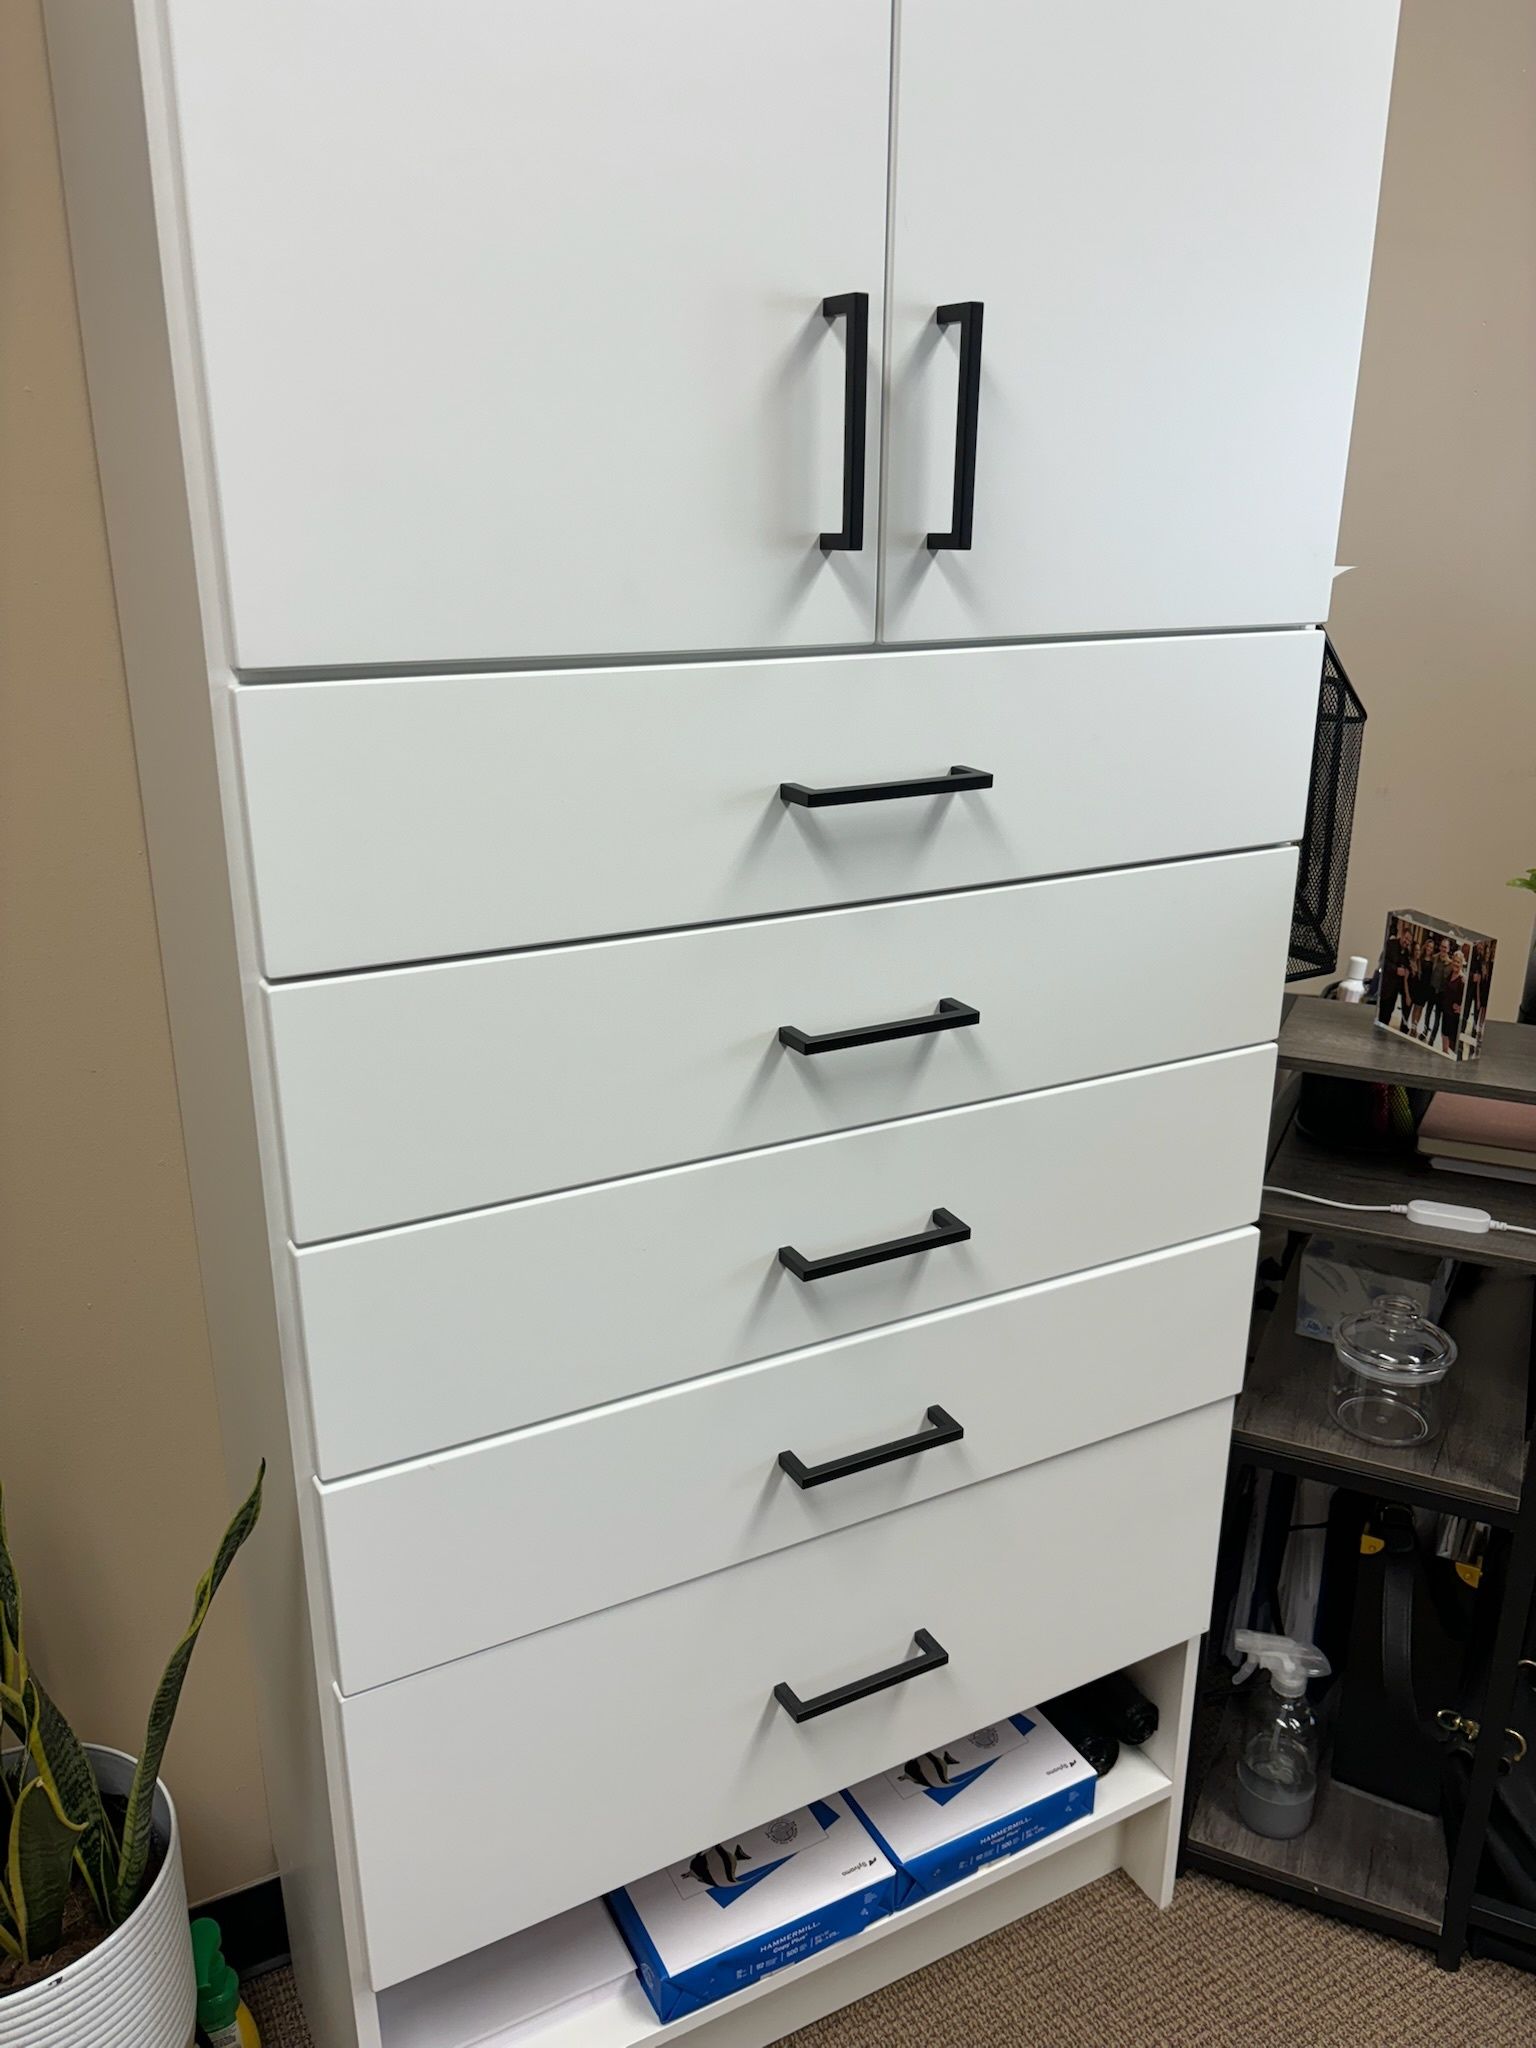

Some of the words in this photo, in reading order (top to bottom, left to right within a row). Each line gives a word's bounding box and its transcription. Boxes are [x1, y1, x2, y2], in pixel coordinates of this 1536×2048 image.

[980, 1818, 1030, 1845] HAMMERMILL
[760, 1923, 818, 1952] HAMMERMILL
[773, 1941, 790, 1953] Copy
[786, 1947, 798, 1957] 500
